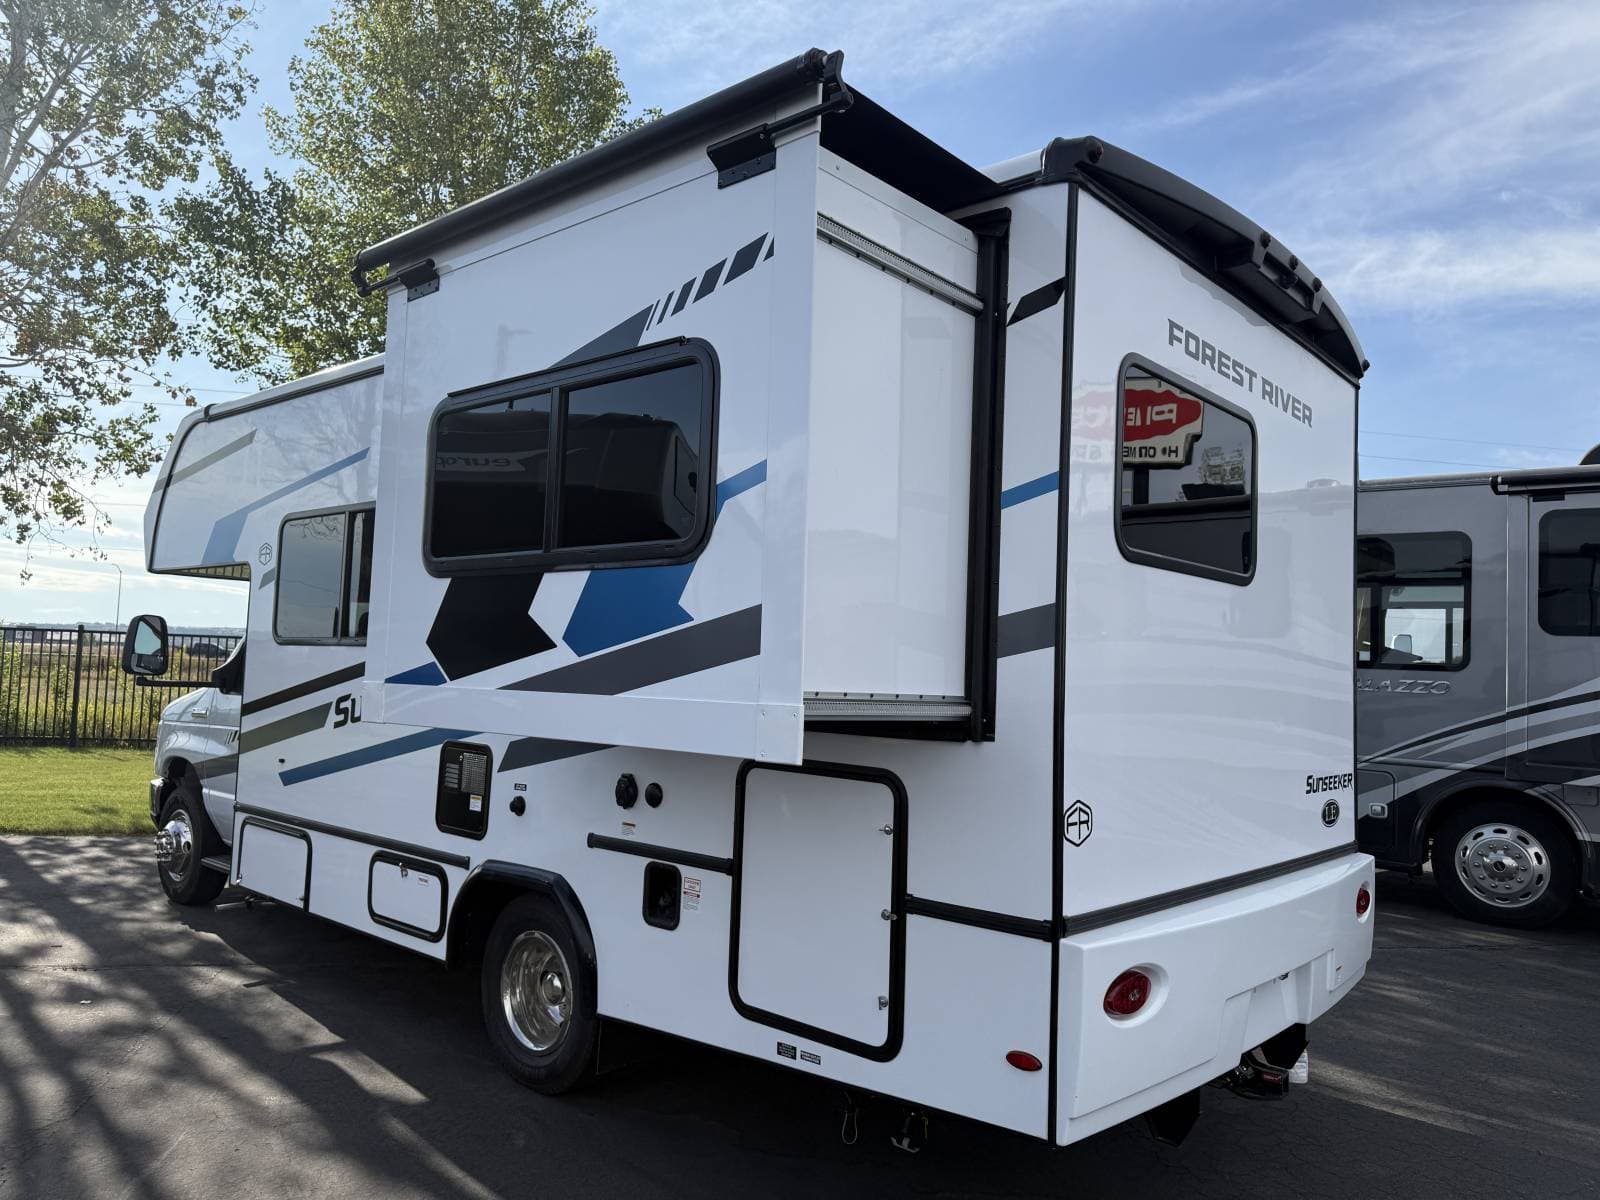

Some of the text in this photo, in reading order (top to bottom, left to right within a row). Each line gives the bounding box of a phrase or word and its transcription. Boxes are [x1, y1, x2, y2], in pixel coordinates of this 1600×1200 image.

[1167, 318, 1313, 429] FOREST RIVER
[1325, 804, 1337, 822] LE
